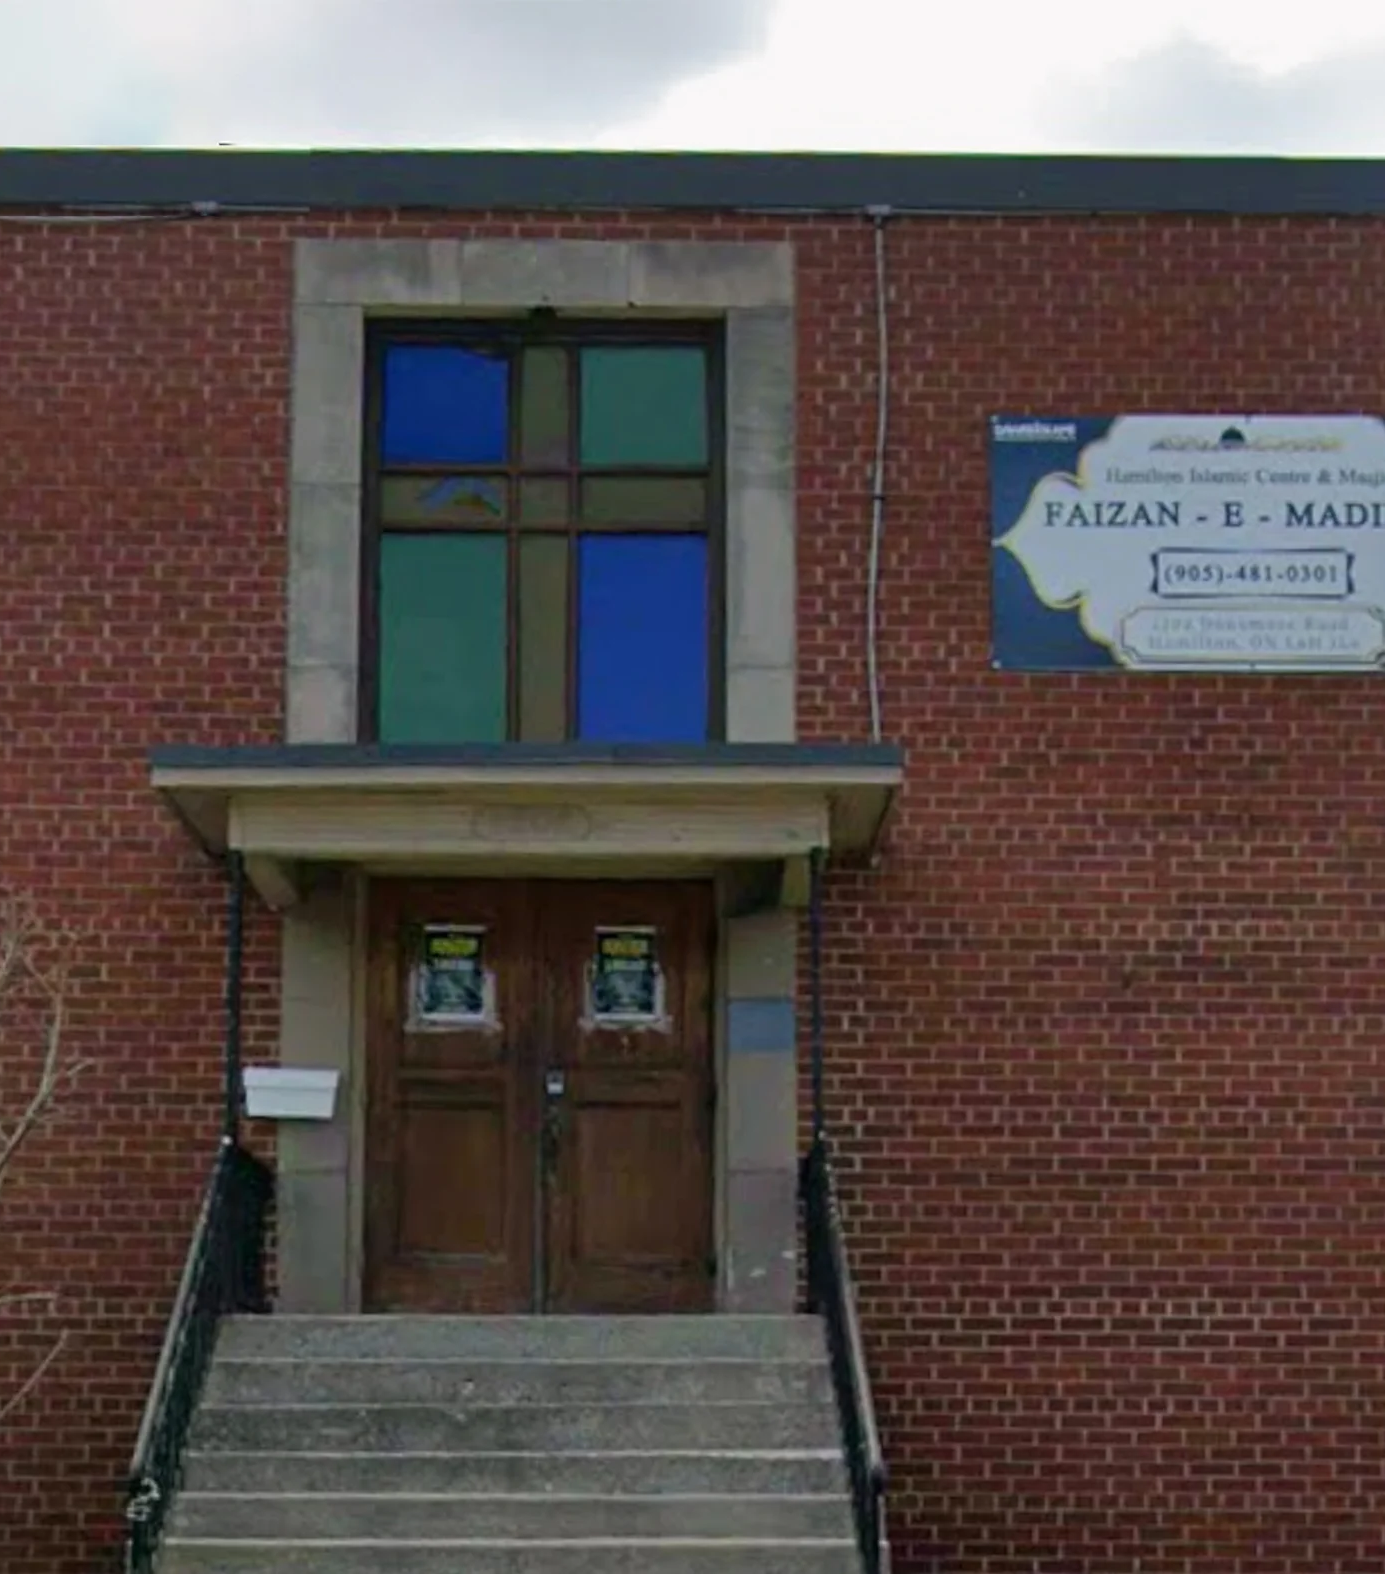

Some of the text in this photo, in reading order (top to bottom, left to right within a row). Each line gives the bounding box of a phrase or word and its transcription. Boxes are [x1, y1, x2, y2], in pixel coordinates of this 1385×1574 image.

[1105, 466, 1184, 484] Hamilton
[1190, 466, 1247, 485] Islamic
[1255, 468, 1311, 485] Centre
[1317, 468, 1332, 485] &
[1045, 501, 1181, 528] FAIZAN
[1223, 502, 1245, 528] E
[1164, 563, 1338, 586] (905)-481-0301
